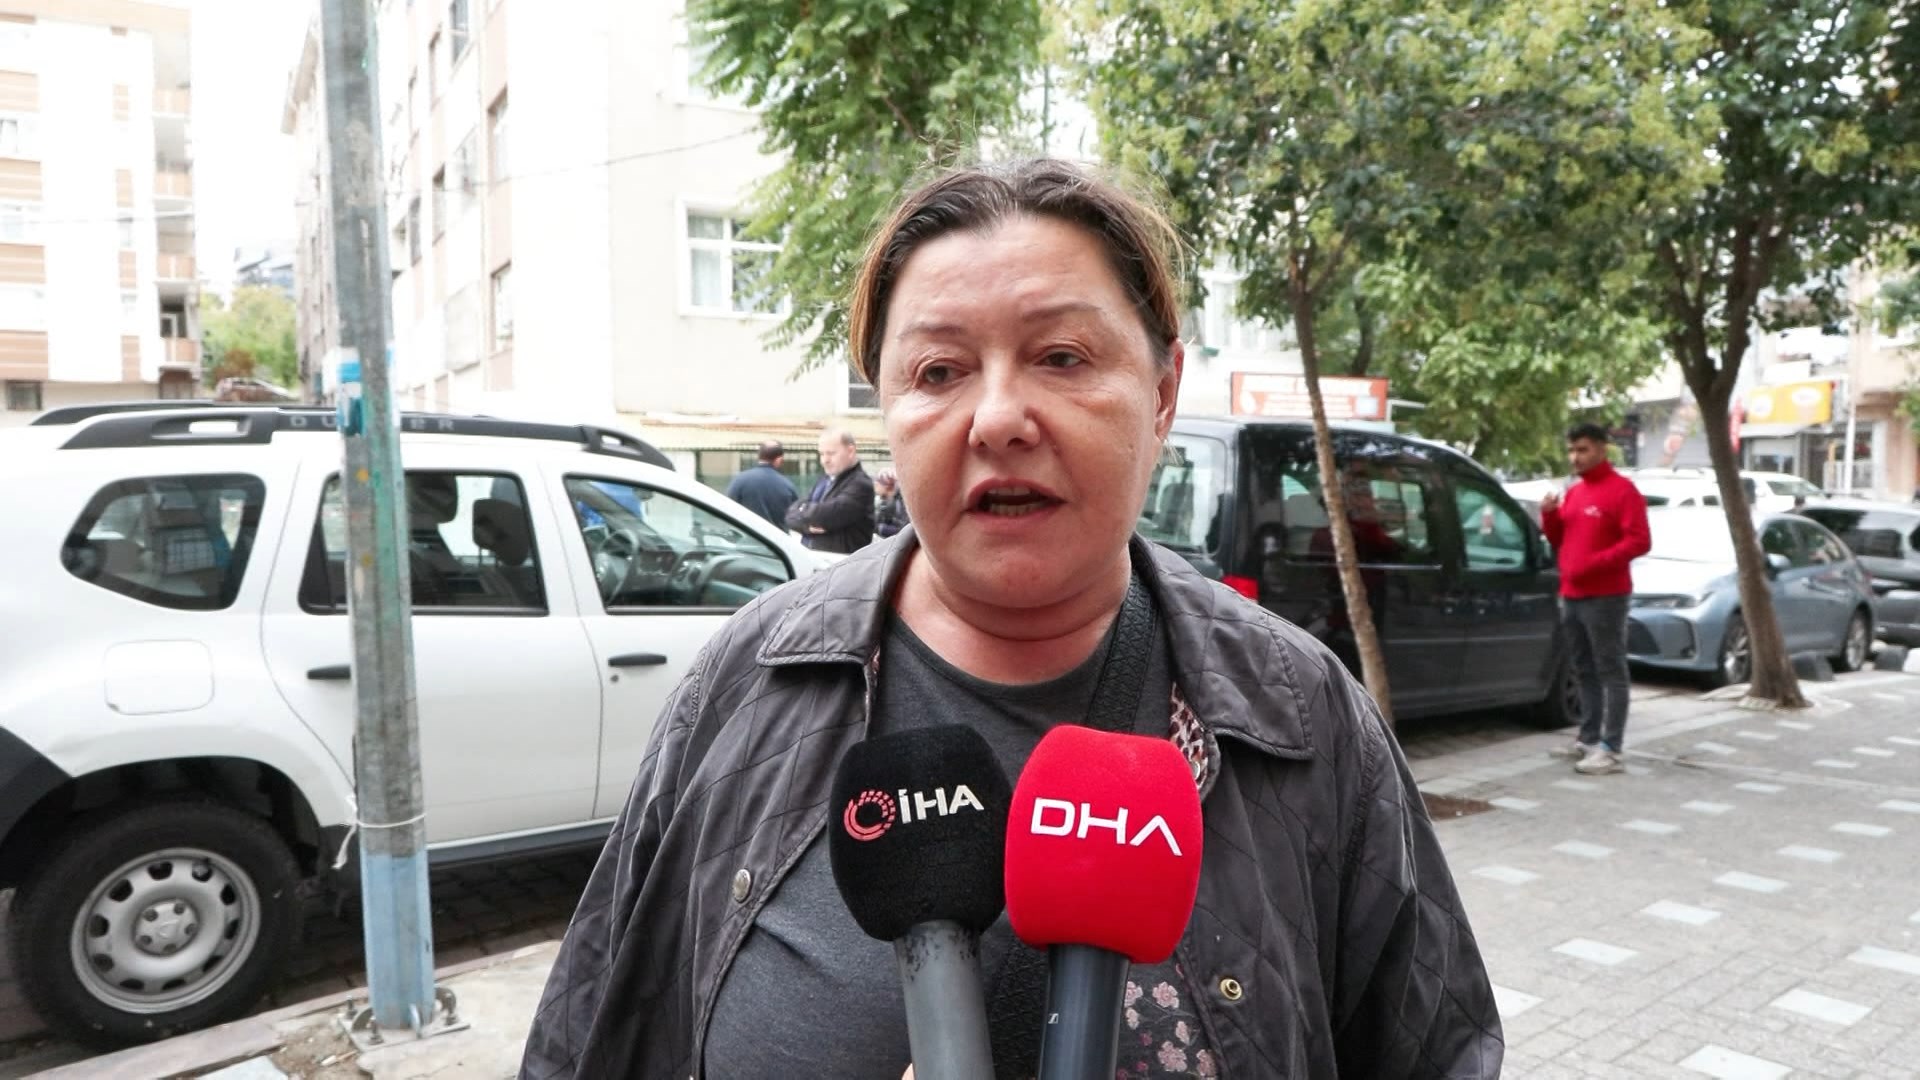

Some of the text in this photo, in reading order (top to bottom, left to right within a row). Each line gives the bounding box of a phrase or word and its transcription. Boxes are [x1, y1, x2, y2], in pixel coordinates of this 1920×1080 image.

[290, 415, 455, 430] DUER
[898, 784, 985, 824] İHA
[1030, 796, 1183, 857] DHA
